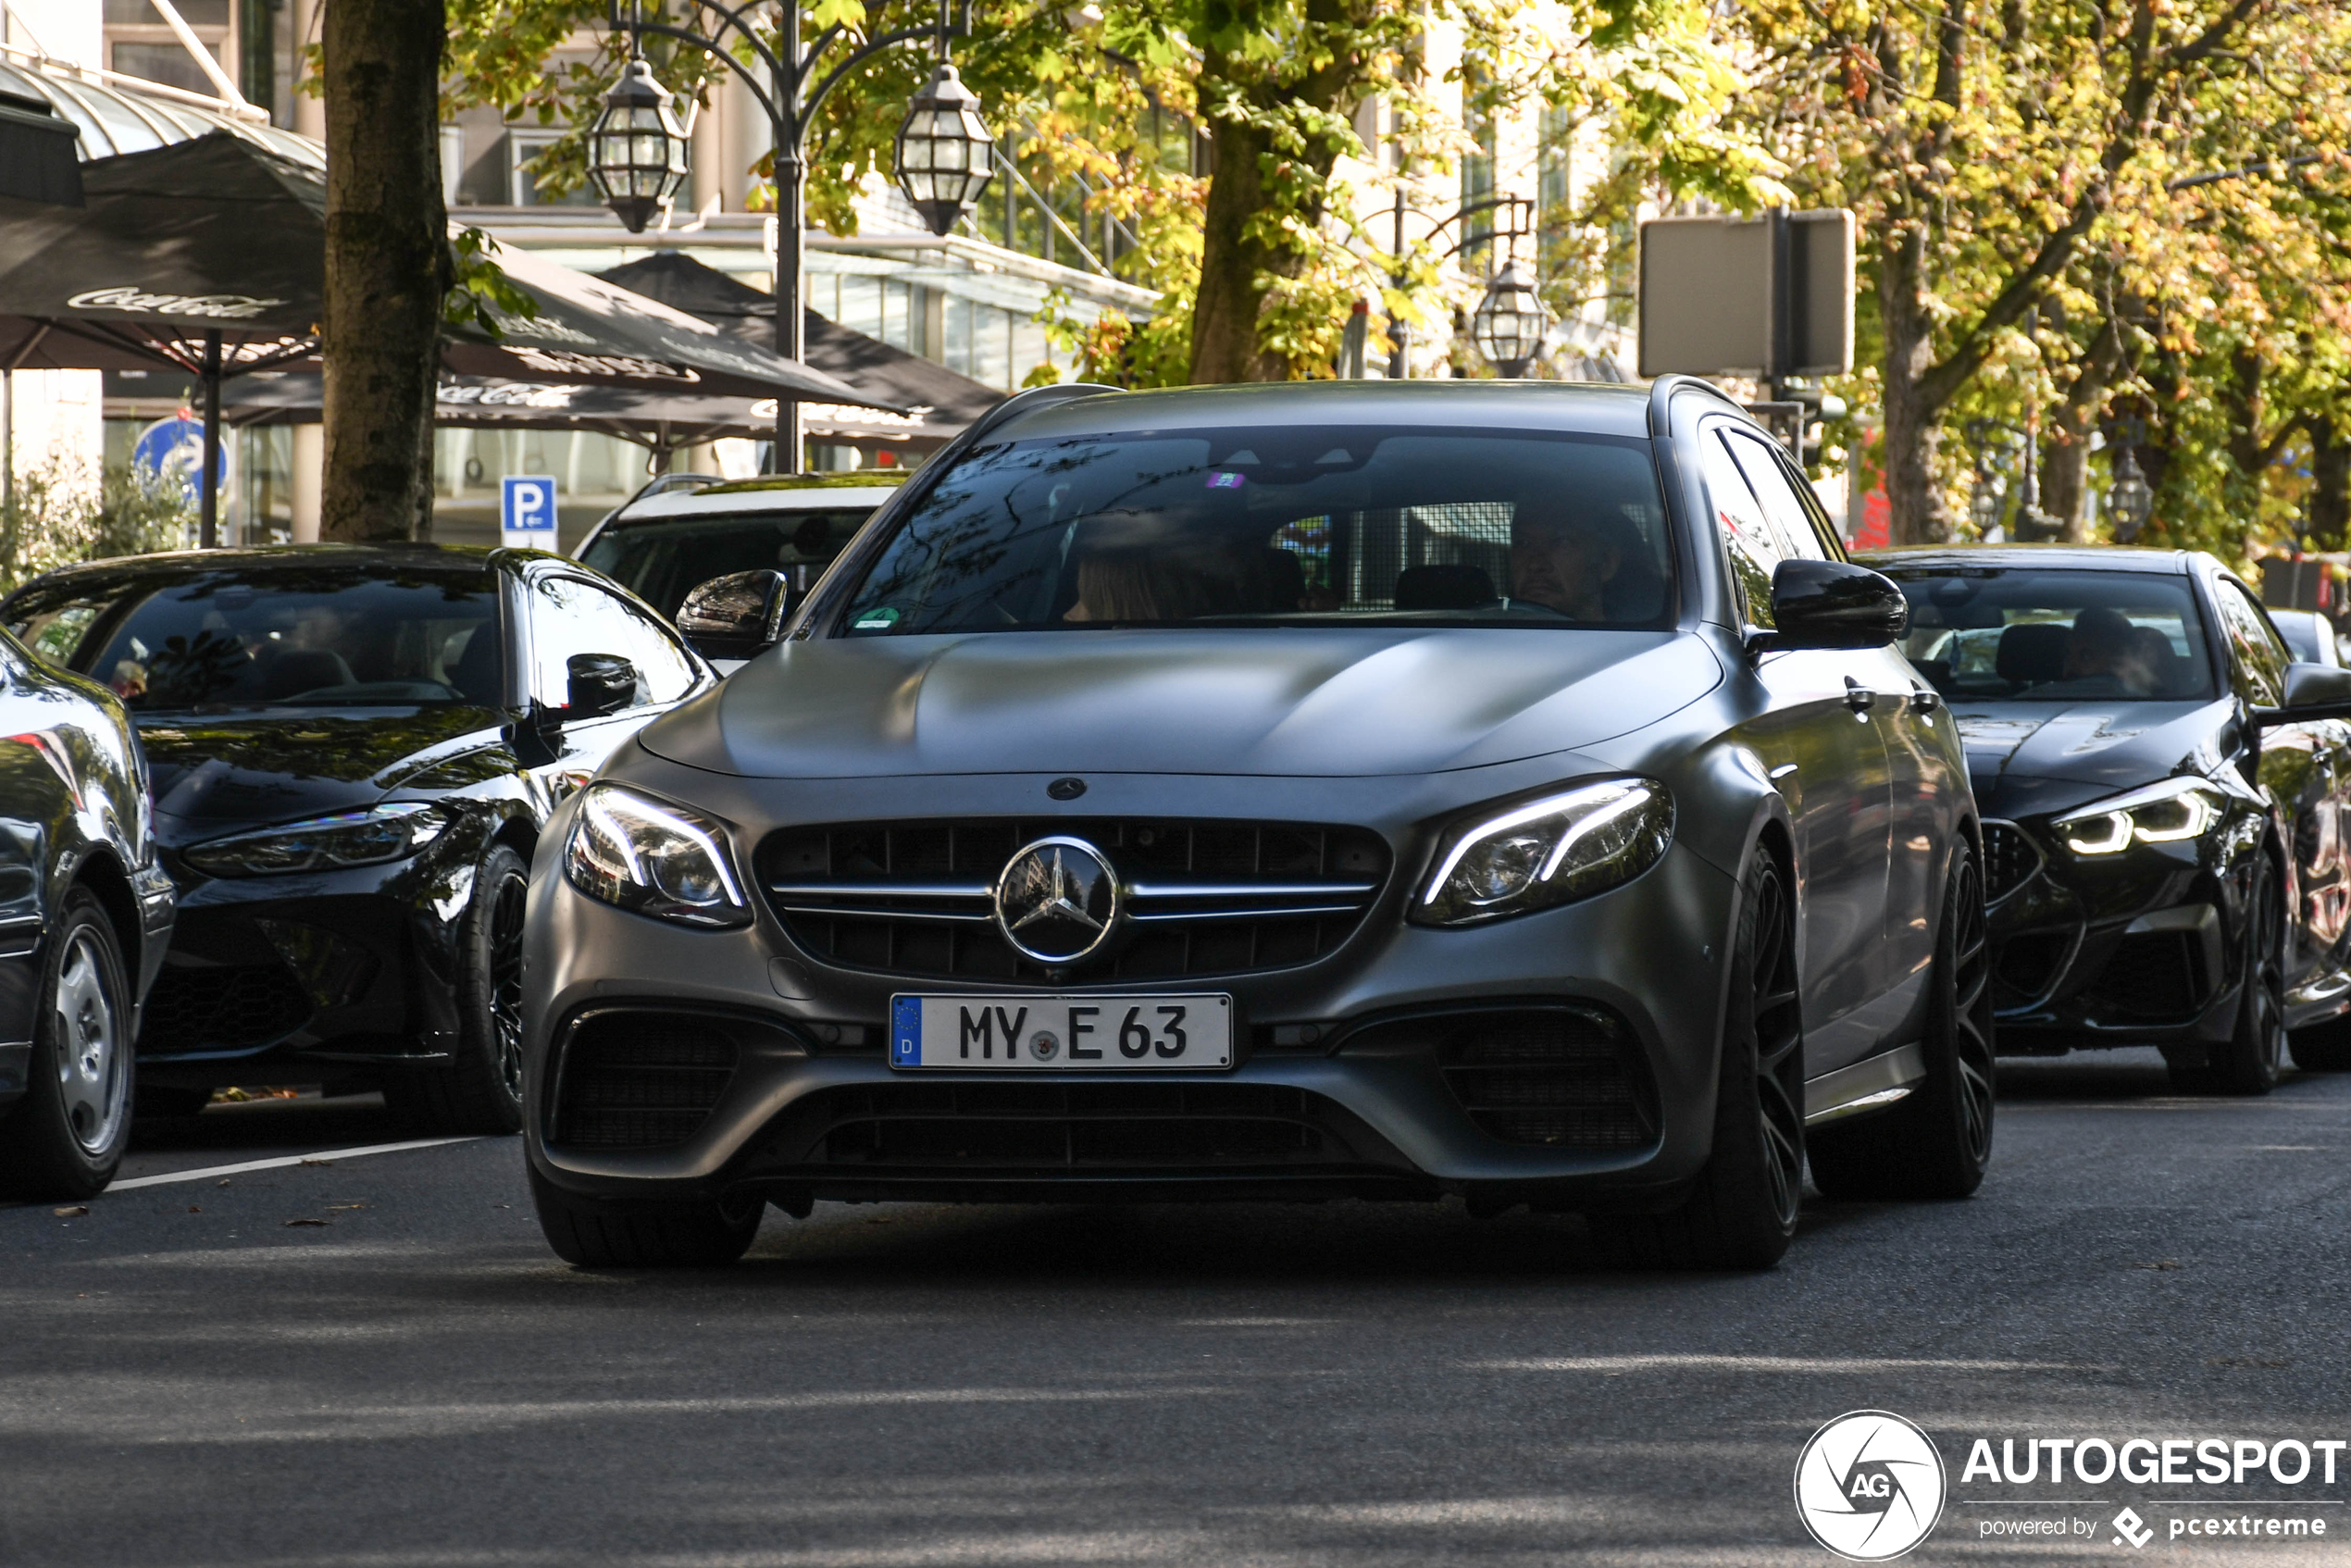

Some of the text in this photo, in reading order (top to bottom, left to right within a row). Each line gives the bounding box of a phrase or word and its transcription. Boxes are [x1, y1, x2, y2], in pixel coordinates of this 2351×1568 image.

[514, 482, 544, 529] P
[873, 610, 887, 620] 4
[902, 1039, 912, 1054] D
[960, 1005, 1028, 1059] MY
[1068, 1006, 1102, 1059] E
[1118, 1005, 1187, 1059] 63
